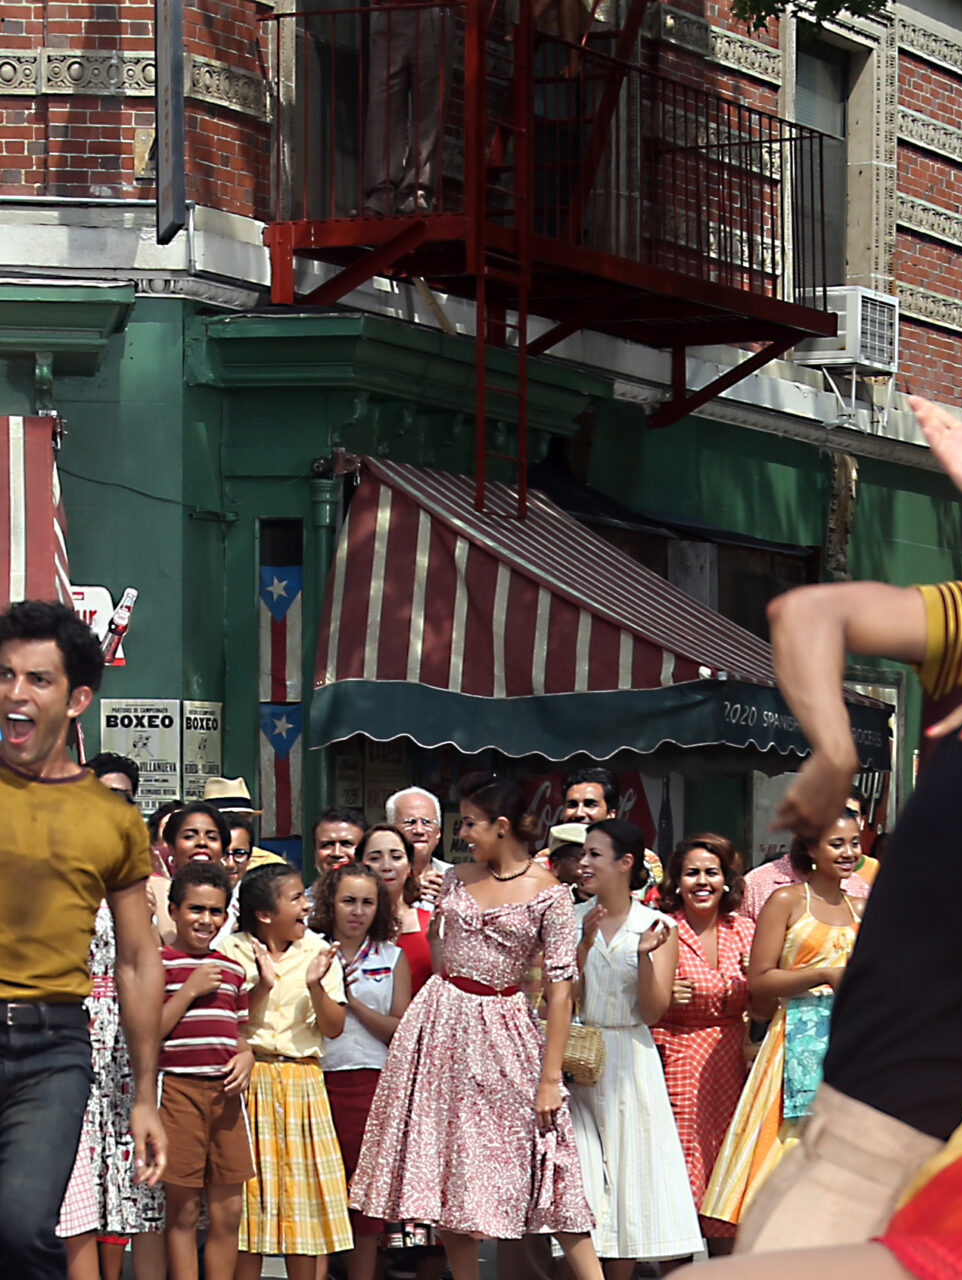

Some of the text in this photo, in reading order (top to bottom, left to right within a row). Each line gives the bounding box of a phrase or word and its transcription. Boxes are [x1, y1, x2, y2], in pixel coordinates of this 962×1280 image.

[106, 714, 174, 729] BOXEO
[723, 701, 757, 727] 2020
[185, 716, 218, 731] BOXEO
